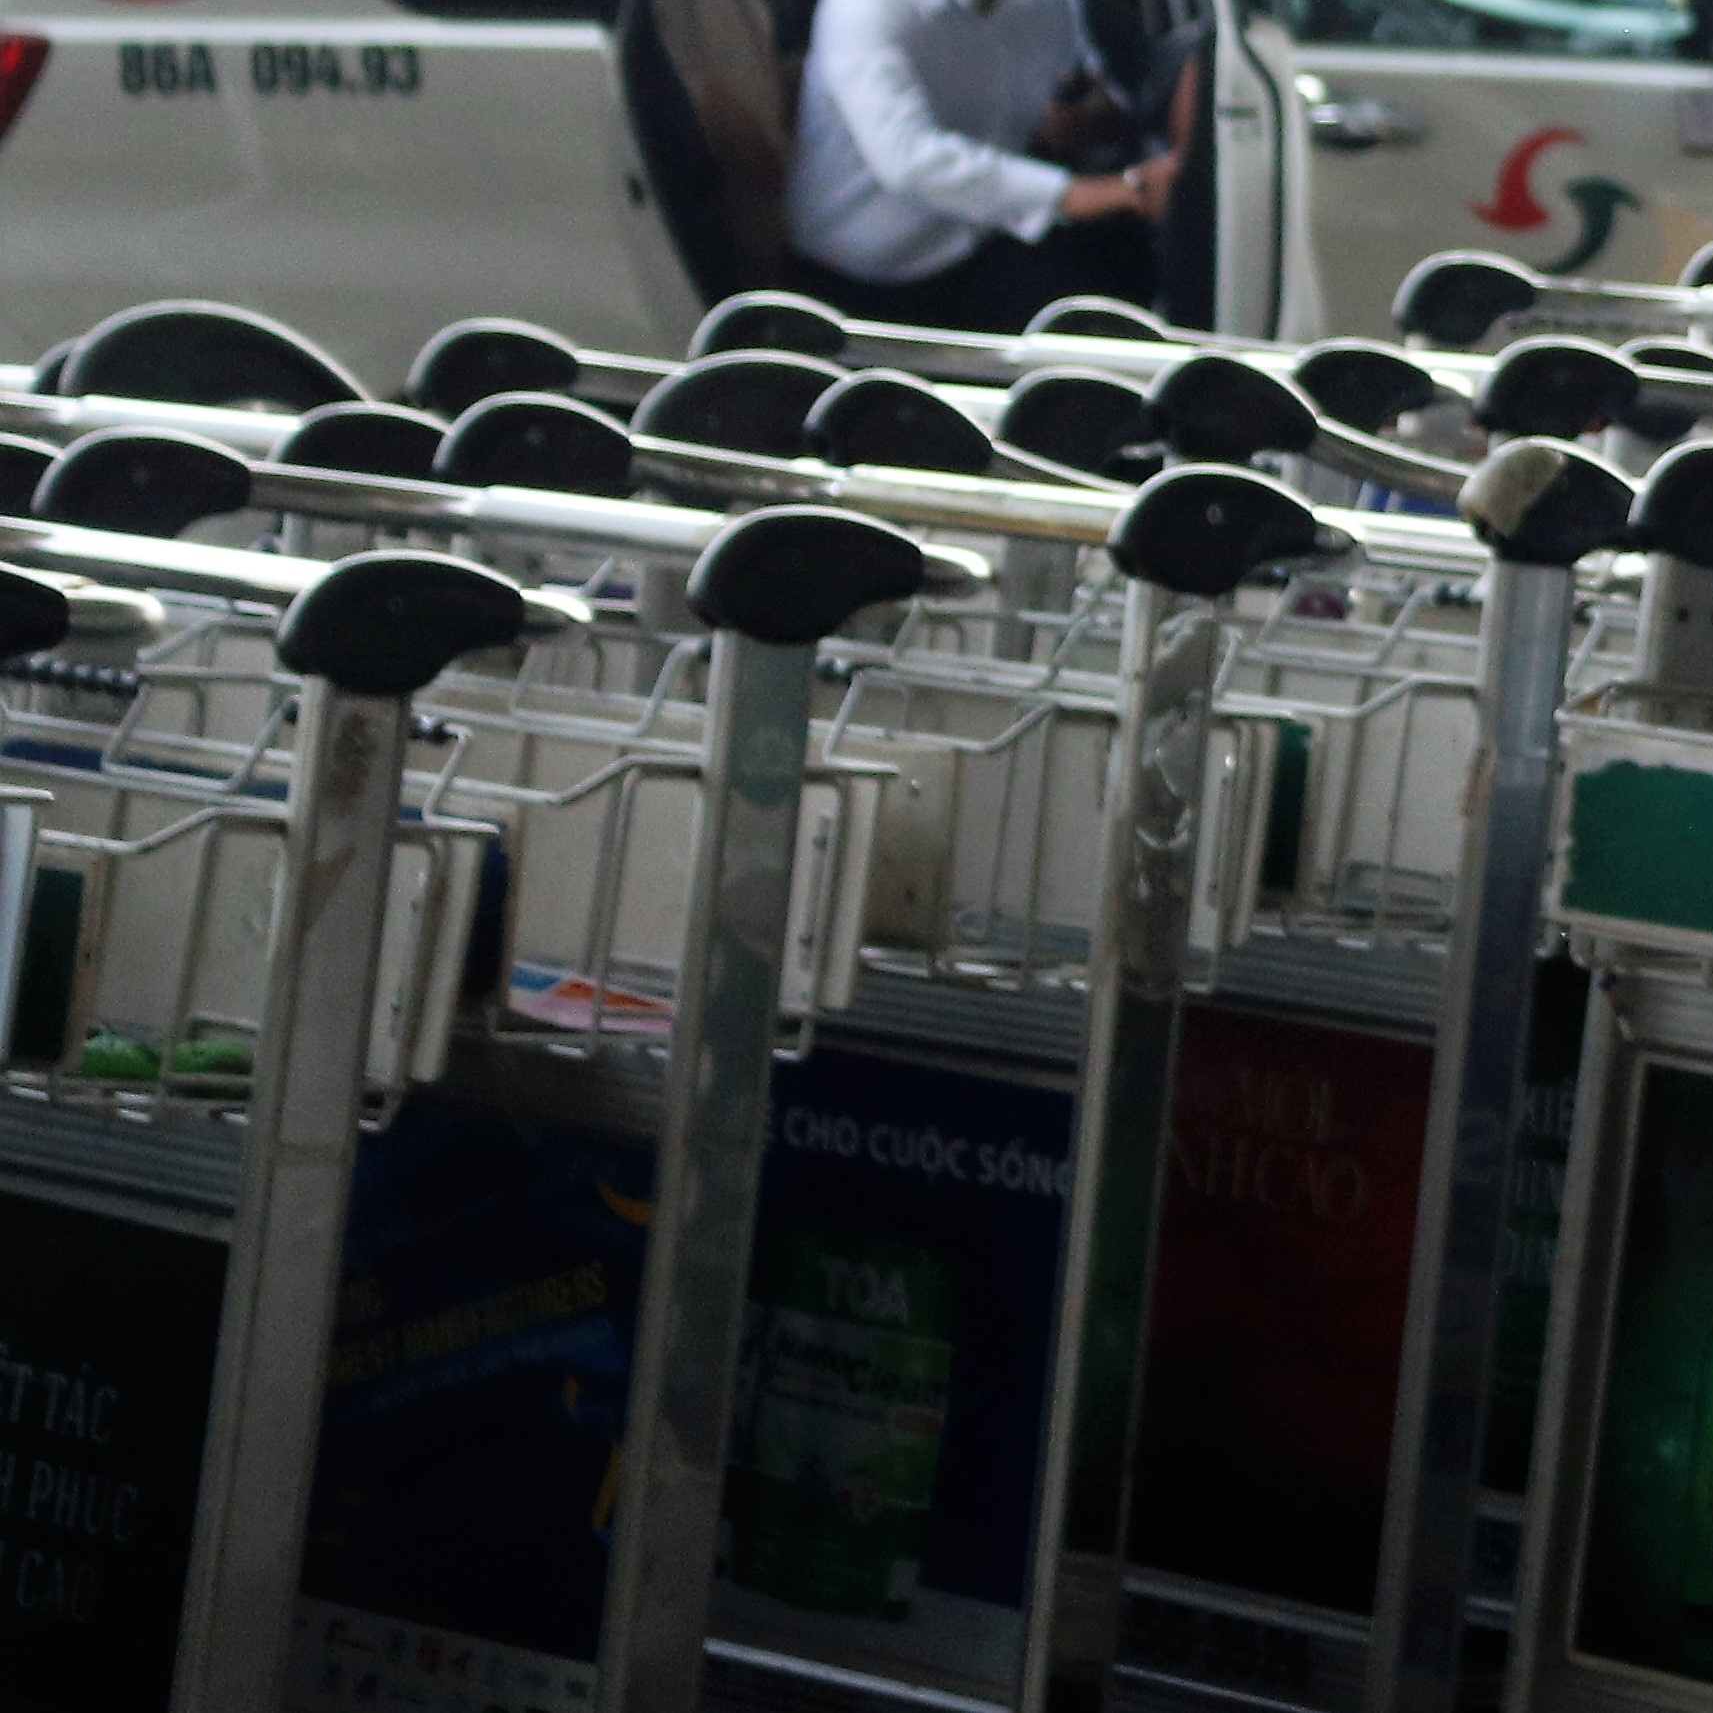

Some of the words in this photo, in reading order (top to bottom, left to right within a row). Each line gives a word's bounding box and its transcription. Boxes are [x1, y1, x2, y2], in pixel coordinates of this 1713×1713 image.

[783, 1106, 860, 1158] CHO
[867, 1123, 970, 1185] CUỘC
[819, 1255, 909, 1324] TOA
